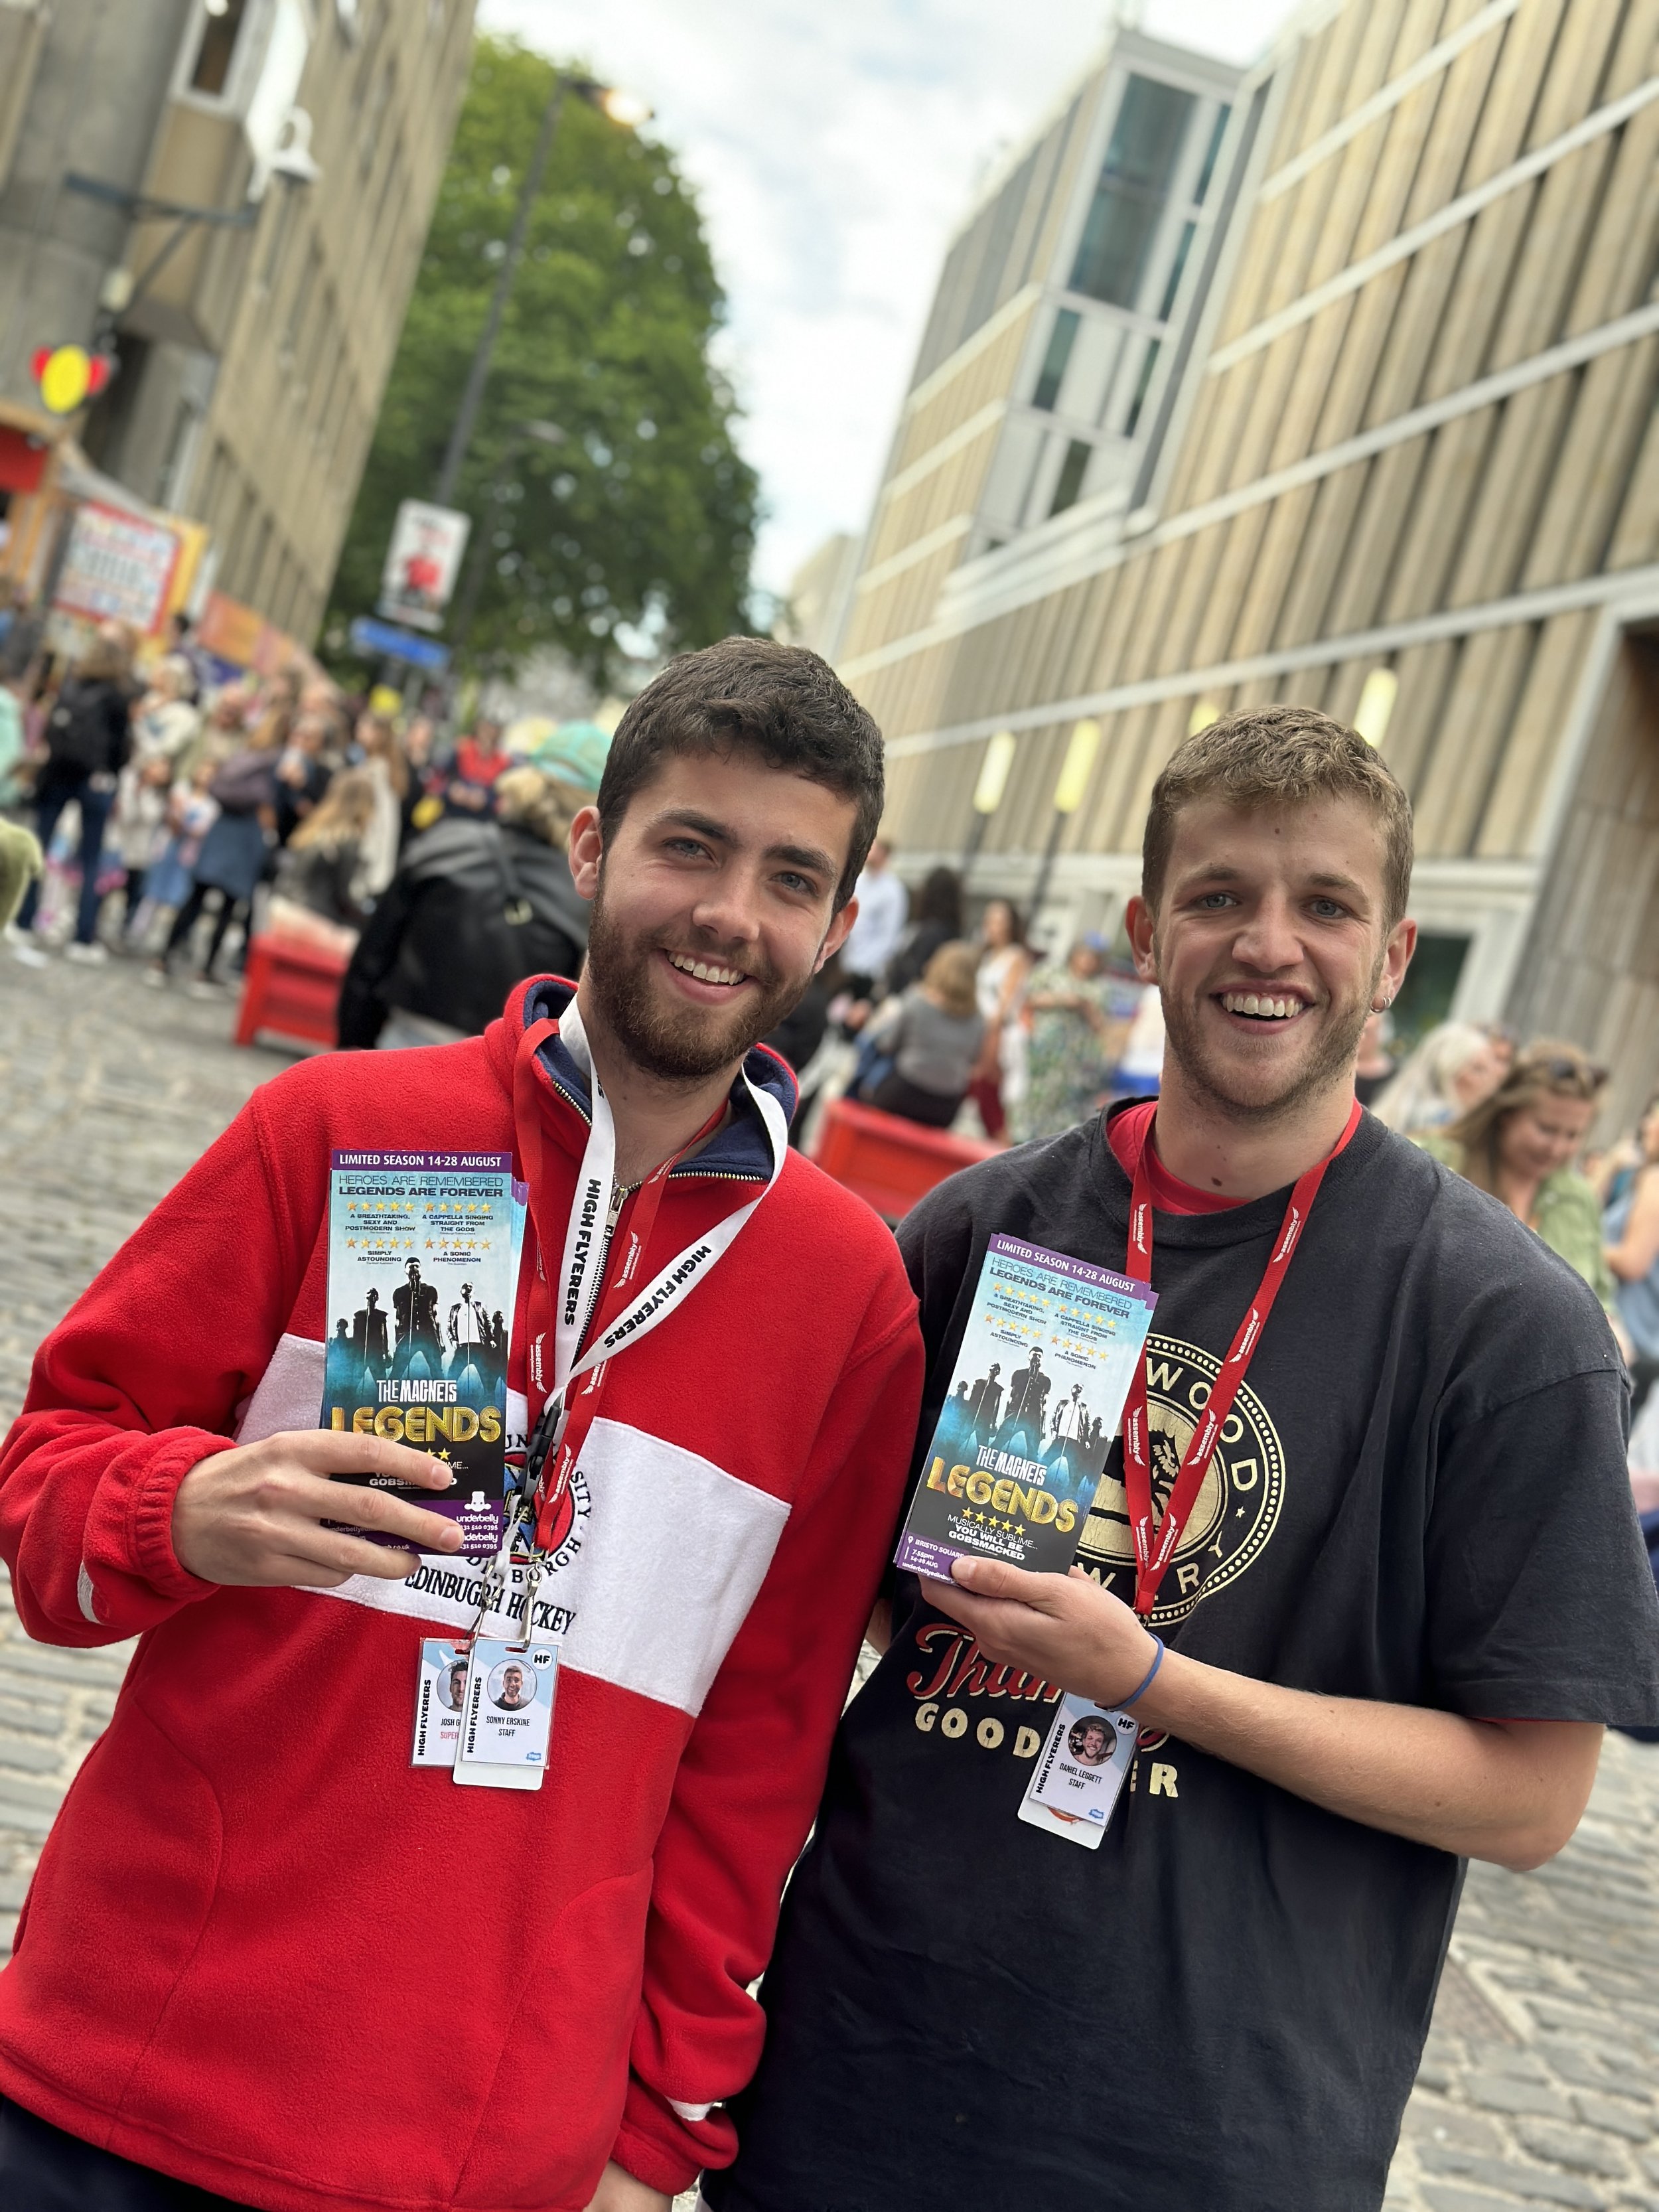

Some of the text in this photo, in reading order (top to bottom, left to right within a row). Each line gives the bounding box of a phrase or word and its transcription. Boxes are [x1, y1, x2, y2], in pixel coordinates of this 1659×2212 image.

[340, 1154, 502, 1167] LIMITED SEASON 14-28 AUGUST
[339, 1175, 503, 1187] HEROES ARE REMEMBERED
[339, 1187, 503, 1197] LEGENDS ARE FOREVER
[564, 1179, 601, 1326] HIGH FLYERERS
[1281, 1218, 1297, 1253] assembly
[622, 1243, 637, 1279] assembly
[672, 1246, 711, 1284] HIGH
[997, 1239, 1135, 1292] LIMITED SEASON 14-28 AUGUST
[989, 1267, 1129, 1319] LEGENDS ARE FOREVER
[992, 1257, 1132, 1309] HEROES ARE REMEMBERED
[604, 1280, 677, 1348] FLYERERS
[1060, 1315, 1090, 1327] CAPPELLA
[1238, 1320, 1256, 1354] assembly
[377, 1380, 457, 1402] THE MAGNETS
[1147, 1357, 1258, 1491] WOOD
[1197, 1422, 1214, 1457] assembly
[975, 1445, 1048, 1487] THE MAGNETS
[927, 1456, 1078, 1532] LEGENDS
[457, 1514, 498, 1524] underbelly
[948, 1514, 995, 1534] MUSICALLY
[915, 1539, 938, 1552] BRISTO
[948, 1530, 1025, 1560] GOBSMACKED
[955, 1524, 977, 1537] YOU
[979, 1531, 1005, 1547] WILL
[1008, 1541, 1023, 1552] BE
[1158, 1526, 1175, 1561] assembly
[926, 1560, 938, 1568] AUG
[534, 1655, 550, 1664] HF
[417, 1679, 431, 1756] HIGH FLYERERS
[467, 1676, 482, 1753] HIGH FLYERERS
[486, 1716, 530, 1726] SONNY ERSKINE
[915, 1702, 1041, 1758] GOOD
[1118, 1718, 1135, 1730] HF
[1036, 1724, 1066, 1794] HIGH FLYERERS
[1059, 1763, 1102, 1784] DANIEL LEGGETT
[1068, 1778, 1086, 1790] STAFF
